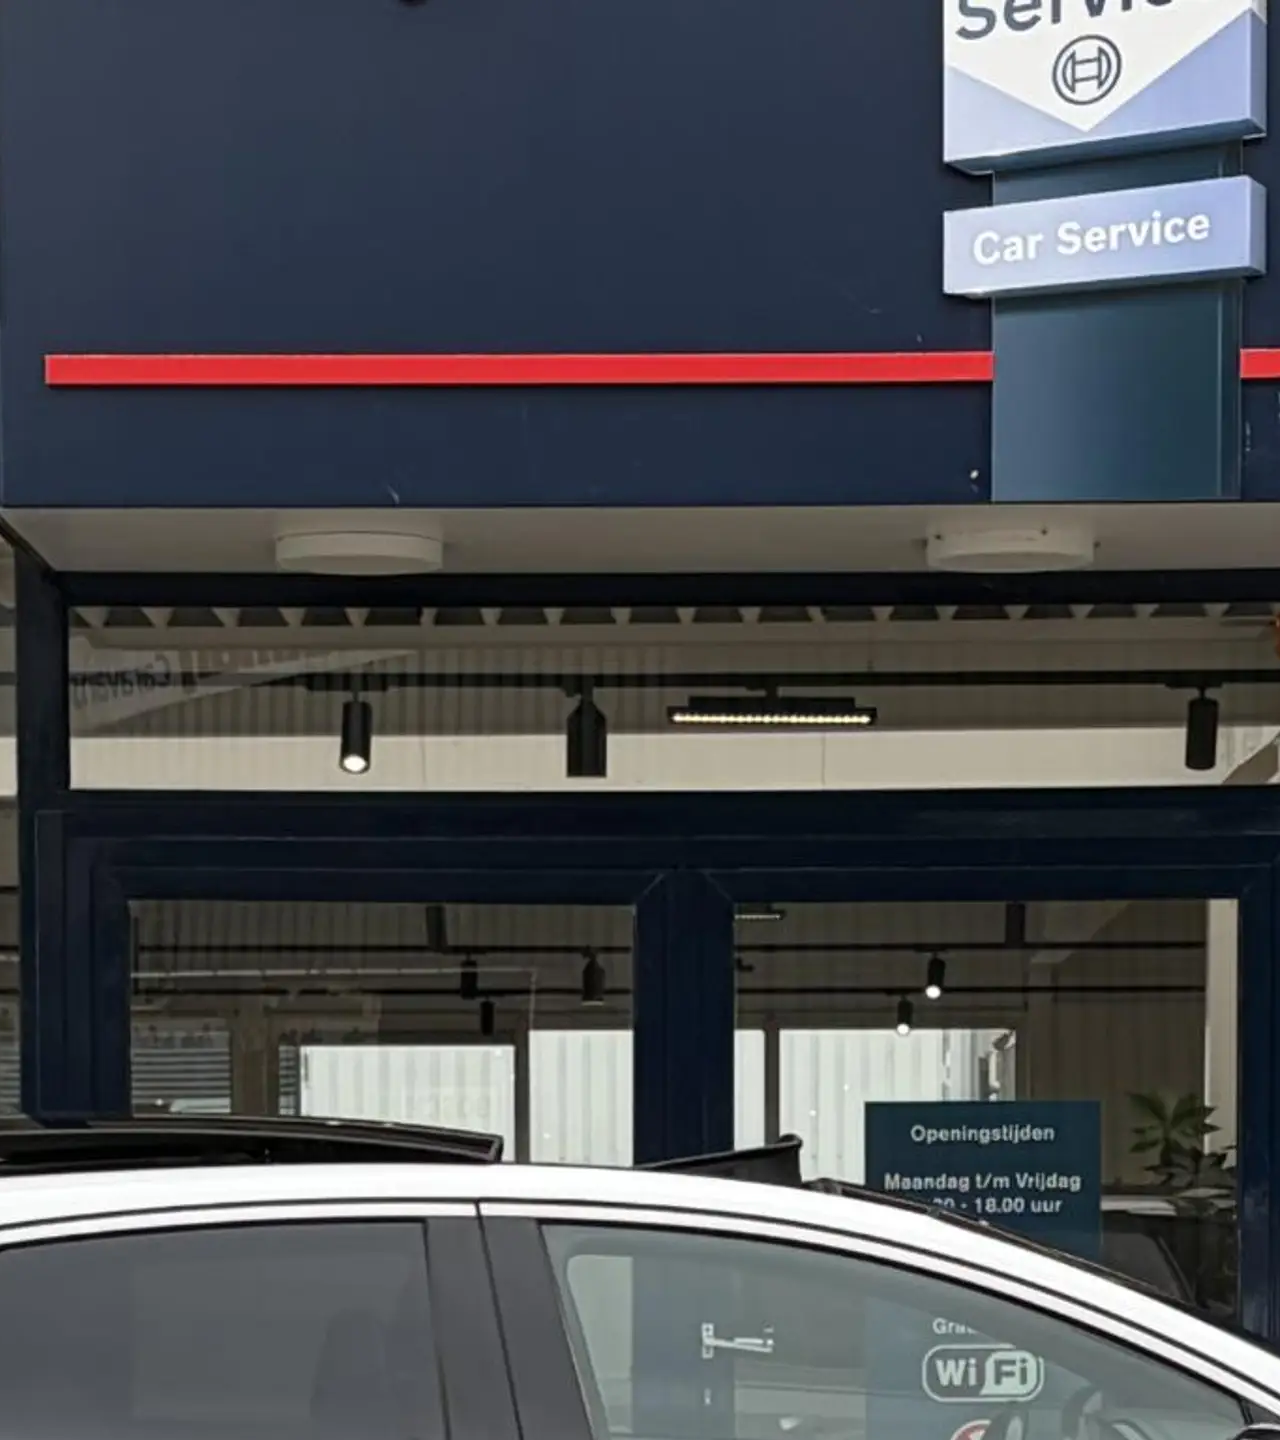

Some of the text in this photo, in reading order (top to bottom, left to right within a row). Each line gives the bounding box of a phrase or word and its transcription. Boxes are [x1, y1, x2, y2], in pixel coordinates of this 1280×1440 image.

[973, 210, 1211, 266] Car Service
[910, 1124, 1055, 1144] Openingstijden
[883, 1172, 1082, 1192] Maandag t/m Vrijdag
[974, 1197, 1025, 1213] 18.00
[1030, 1200, 1063, 1213] uur
